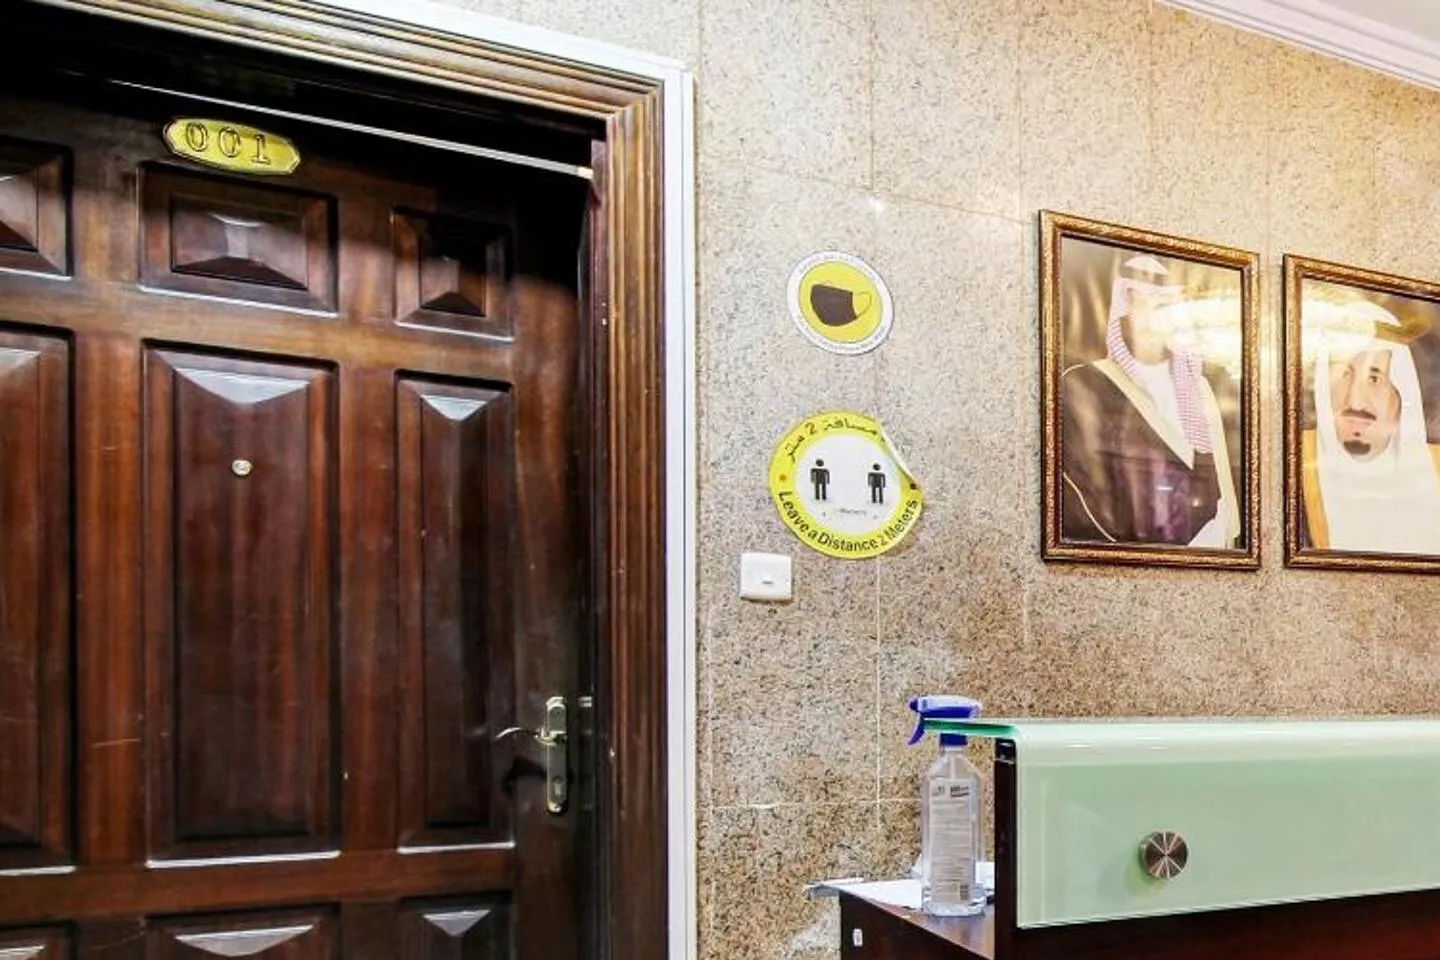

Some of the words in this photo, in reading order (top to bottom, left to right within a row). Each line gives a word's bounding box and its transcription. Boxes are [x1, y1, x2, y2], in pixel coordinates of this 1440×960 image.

[185, 122, 271, 165] 001
[804, 422, 817, 435] 2
[778, 490, 809, 533] Leave
[808, 530, 818, 540] a
[817, 532, 880, 552] Distance
[878, 534, 889, 547] 2
[884, 500, 919, 539] Meters
